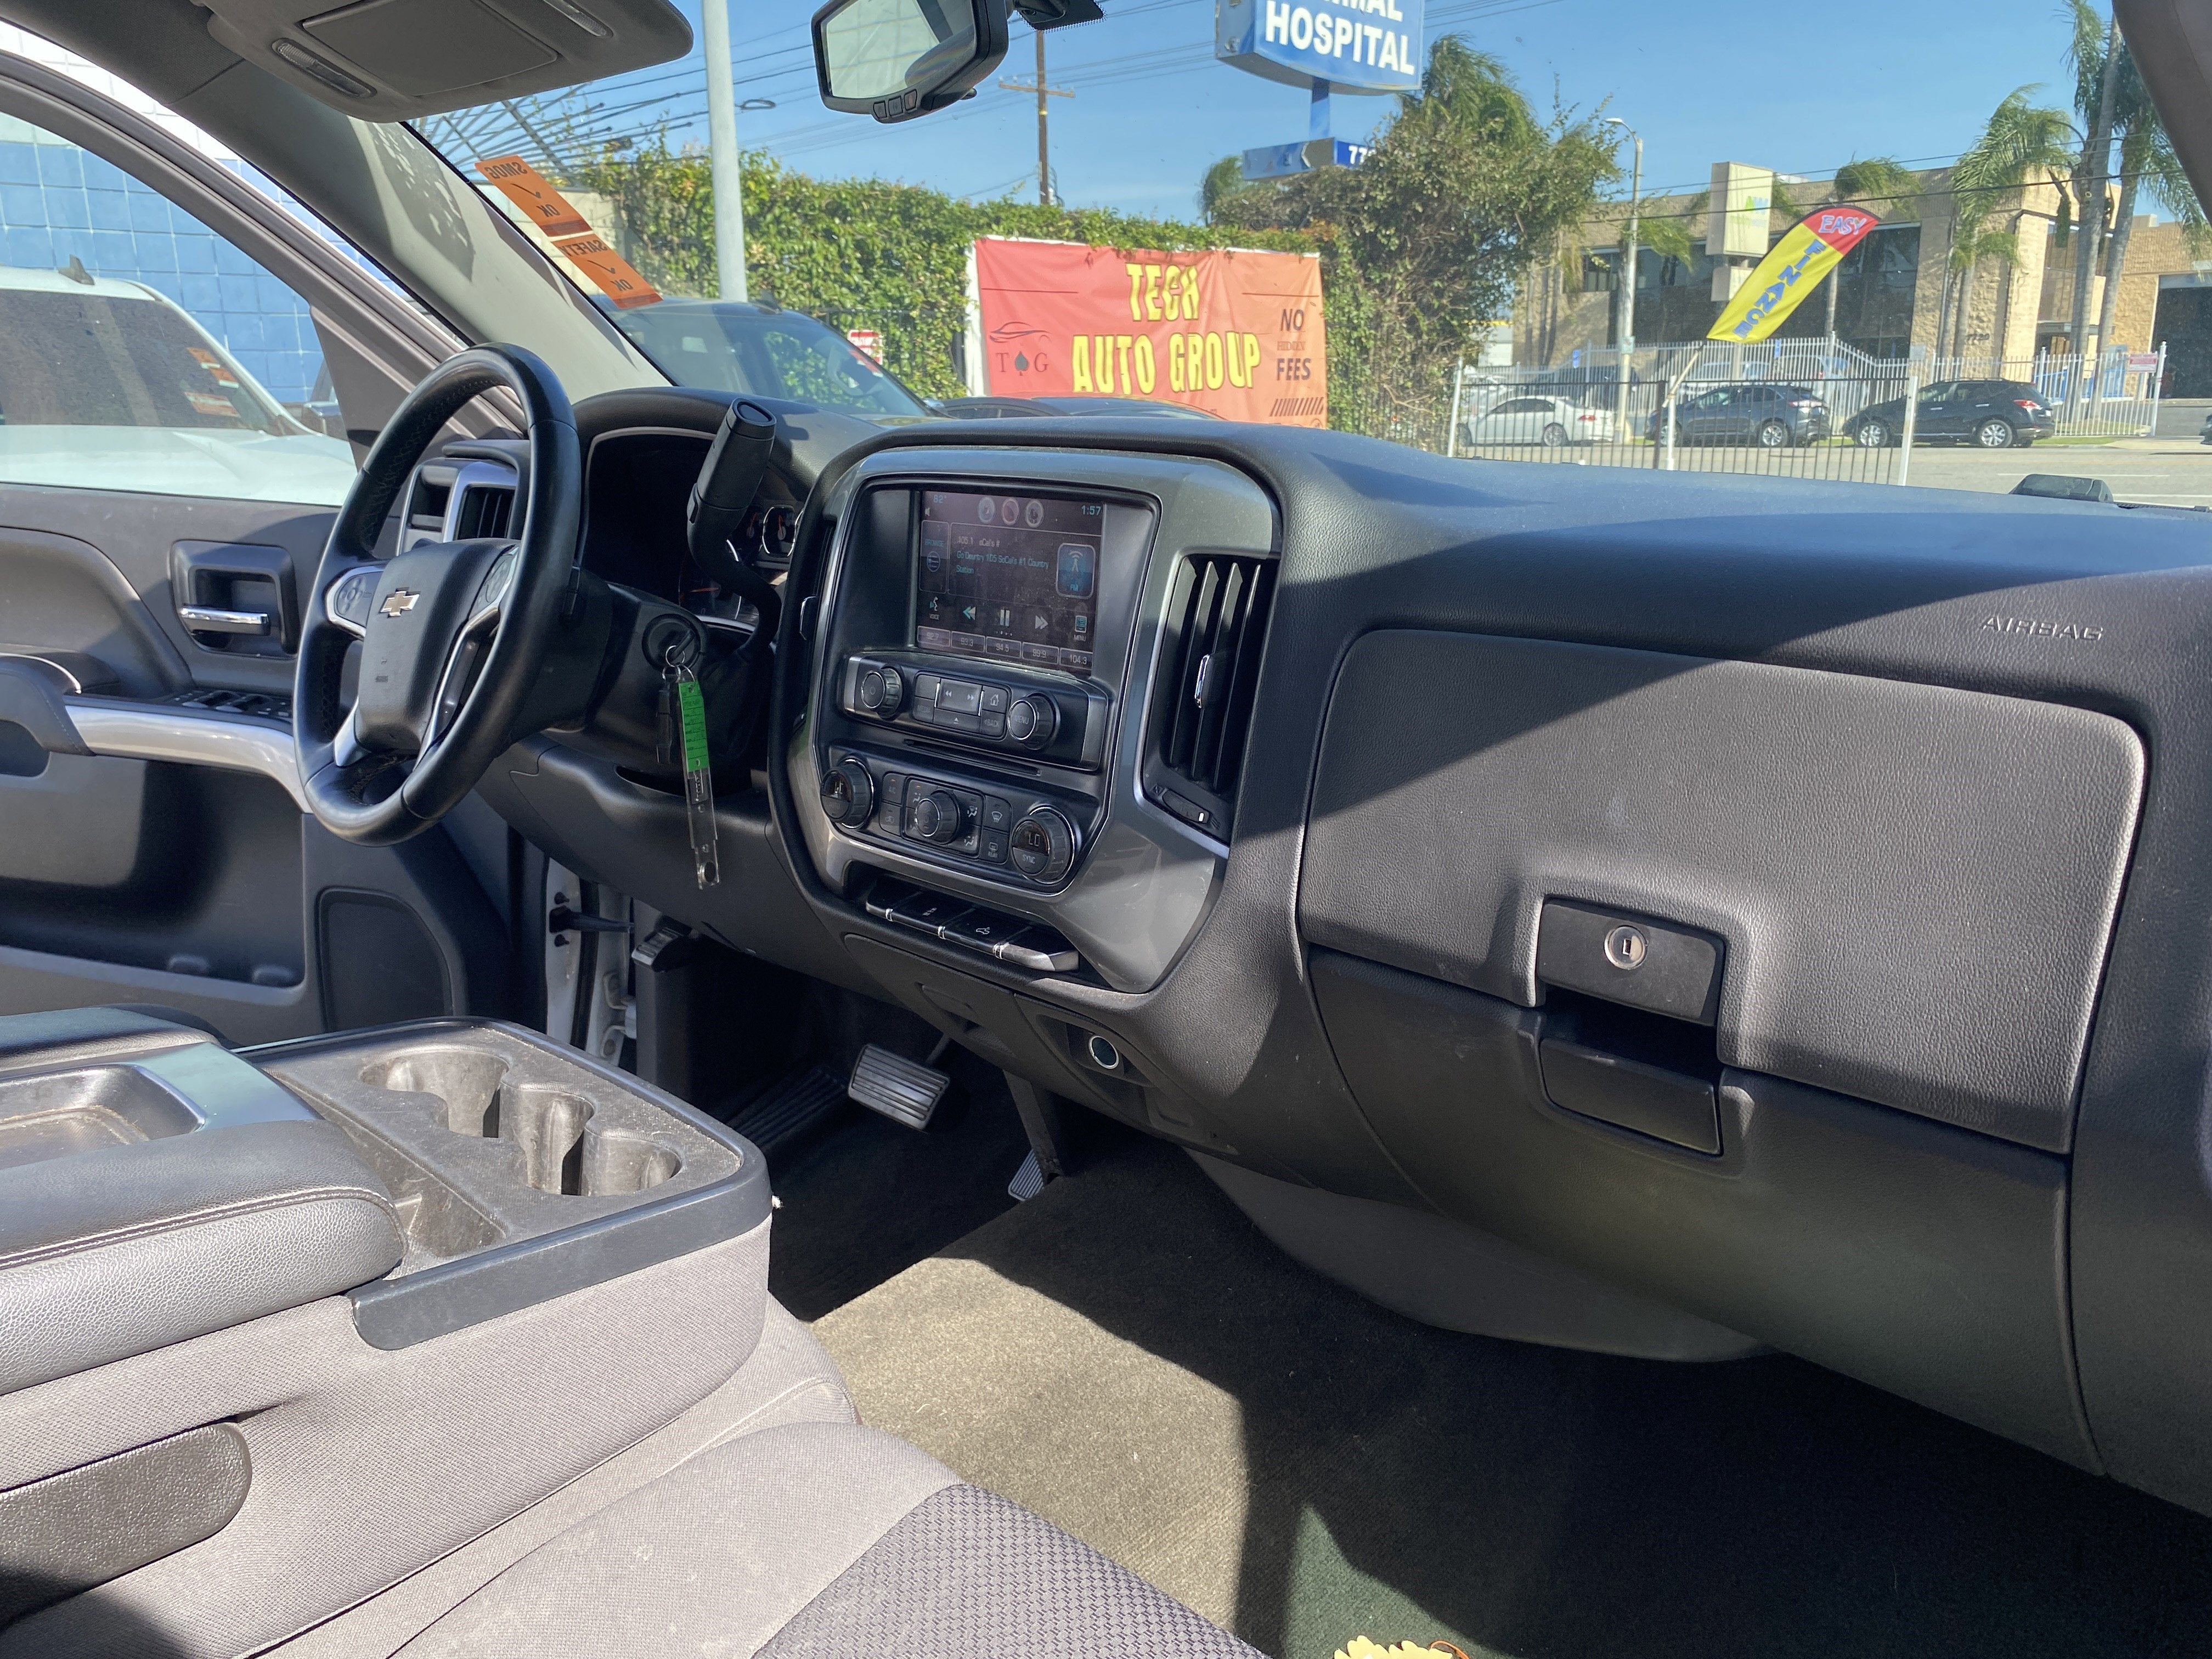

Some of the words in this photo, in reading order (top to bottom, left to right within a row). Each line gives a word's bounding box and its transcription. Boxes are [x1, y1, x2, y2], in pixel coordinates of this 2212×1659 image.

[1266, 0, 1415, 75] HOSPITAL
[1819, 215, 1866, 236] EASY
[1125, 263, 1200, 321] TECH
[1733, 239, 1827, 339] FINANCE
[1280, 309, 1304, 331] NO
[1072, 334, 1156, 394] AUTO
[1169, 331, 1261, 393] GROUP
[1276, 358, 1311, 381] FEES
[1082, 505, 1101, 516] 1:57
[1028, 558, 1049, 570] Country
[1981, 615, 2104, 641] AIRBAG
[996, 643, 1009, 653] 94.5
[987, 719, 1000, 728] BACK
[1015, 714, 1029, 725] MENU
[1023, 854, 1036, 864] SYNC
